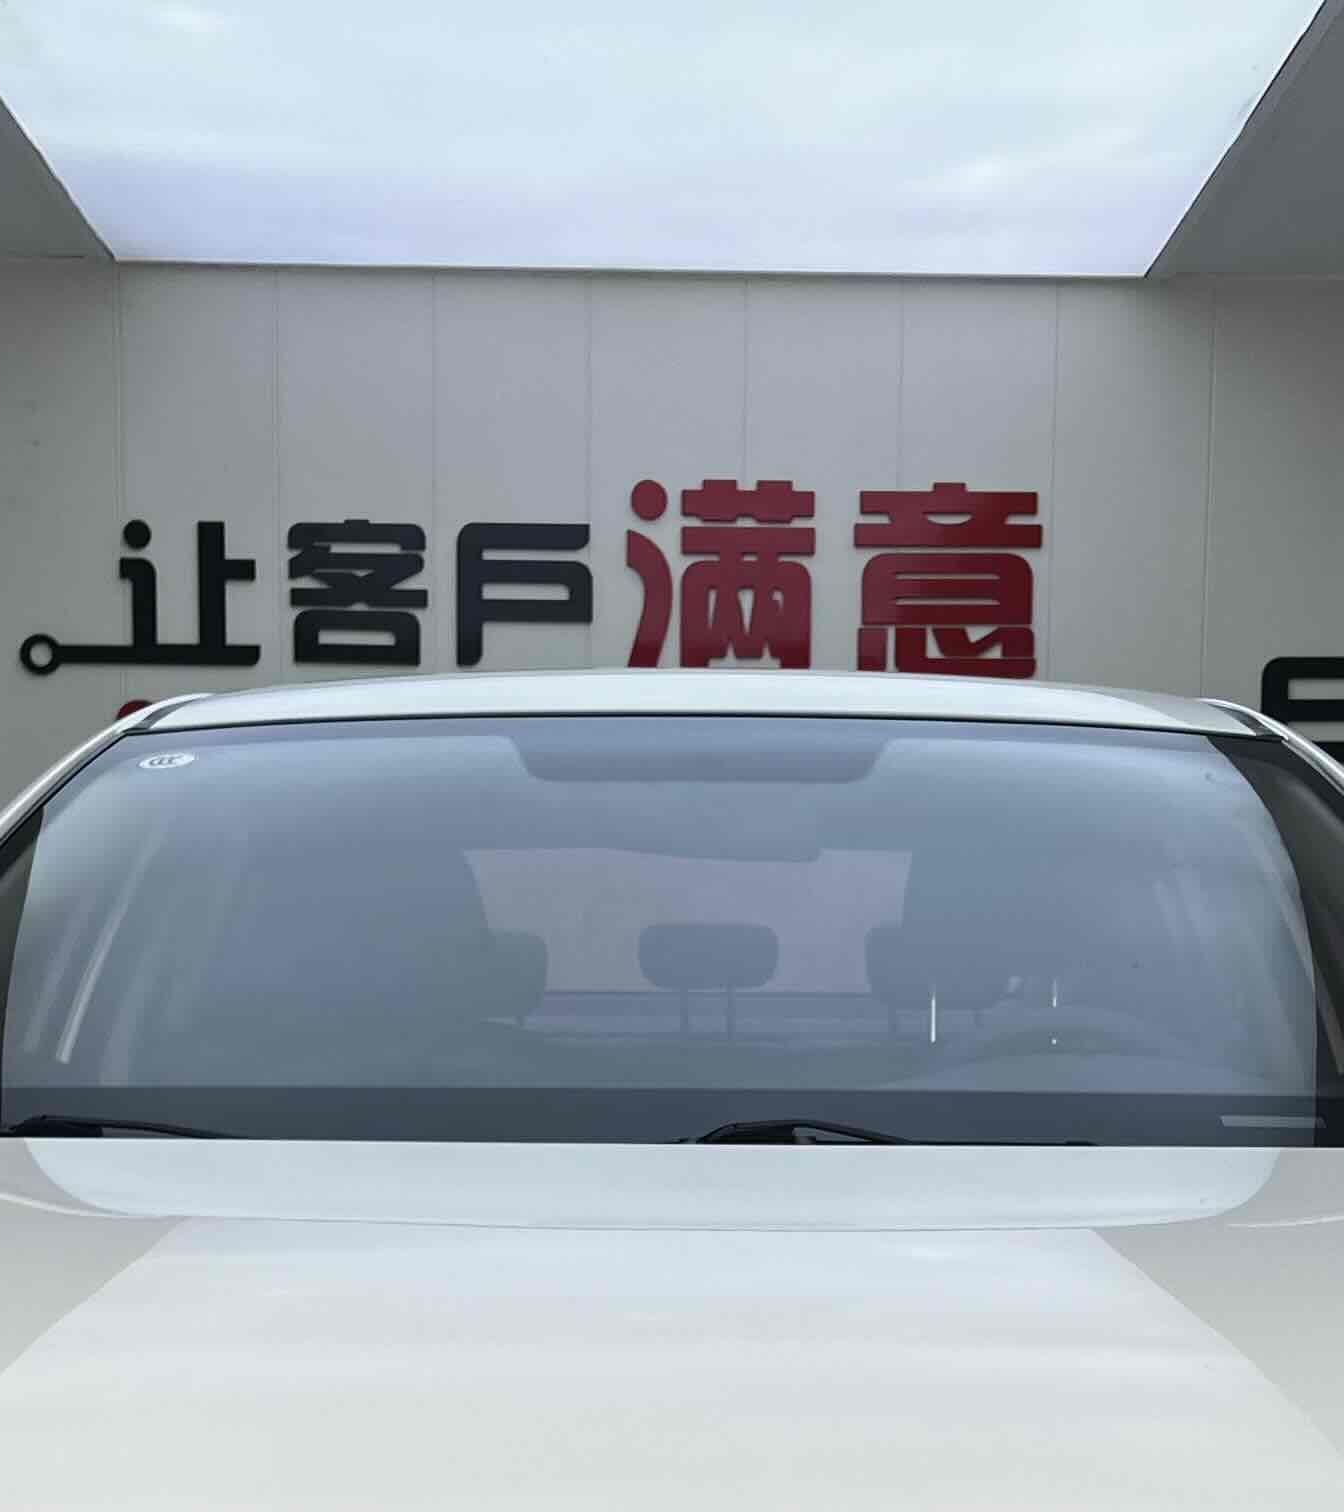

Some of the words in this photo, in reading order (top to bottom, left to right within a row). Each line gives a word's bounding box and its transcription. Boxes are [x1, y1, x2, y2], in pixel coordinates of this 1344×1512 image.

[118, 479, 1043, 678] 让客户满意
